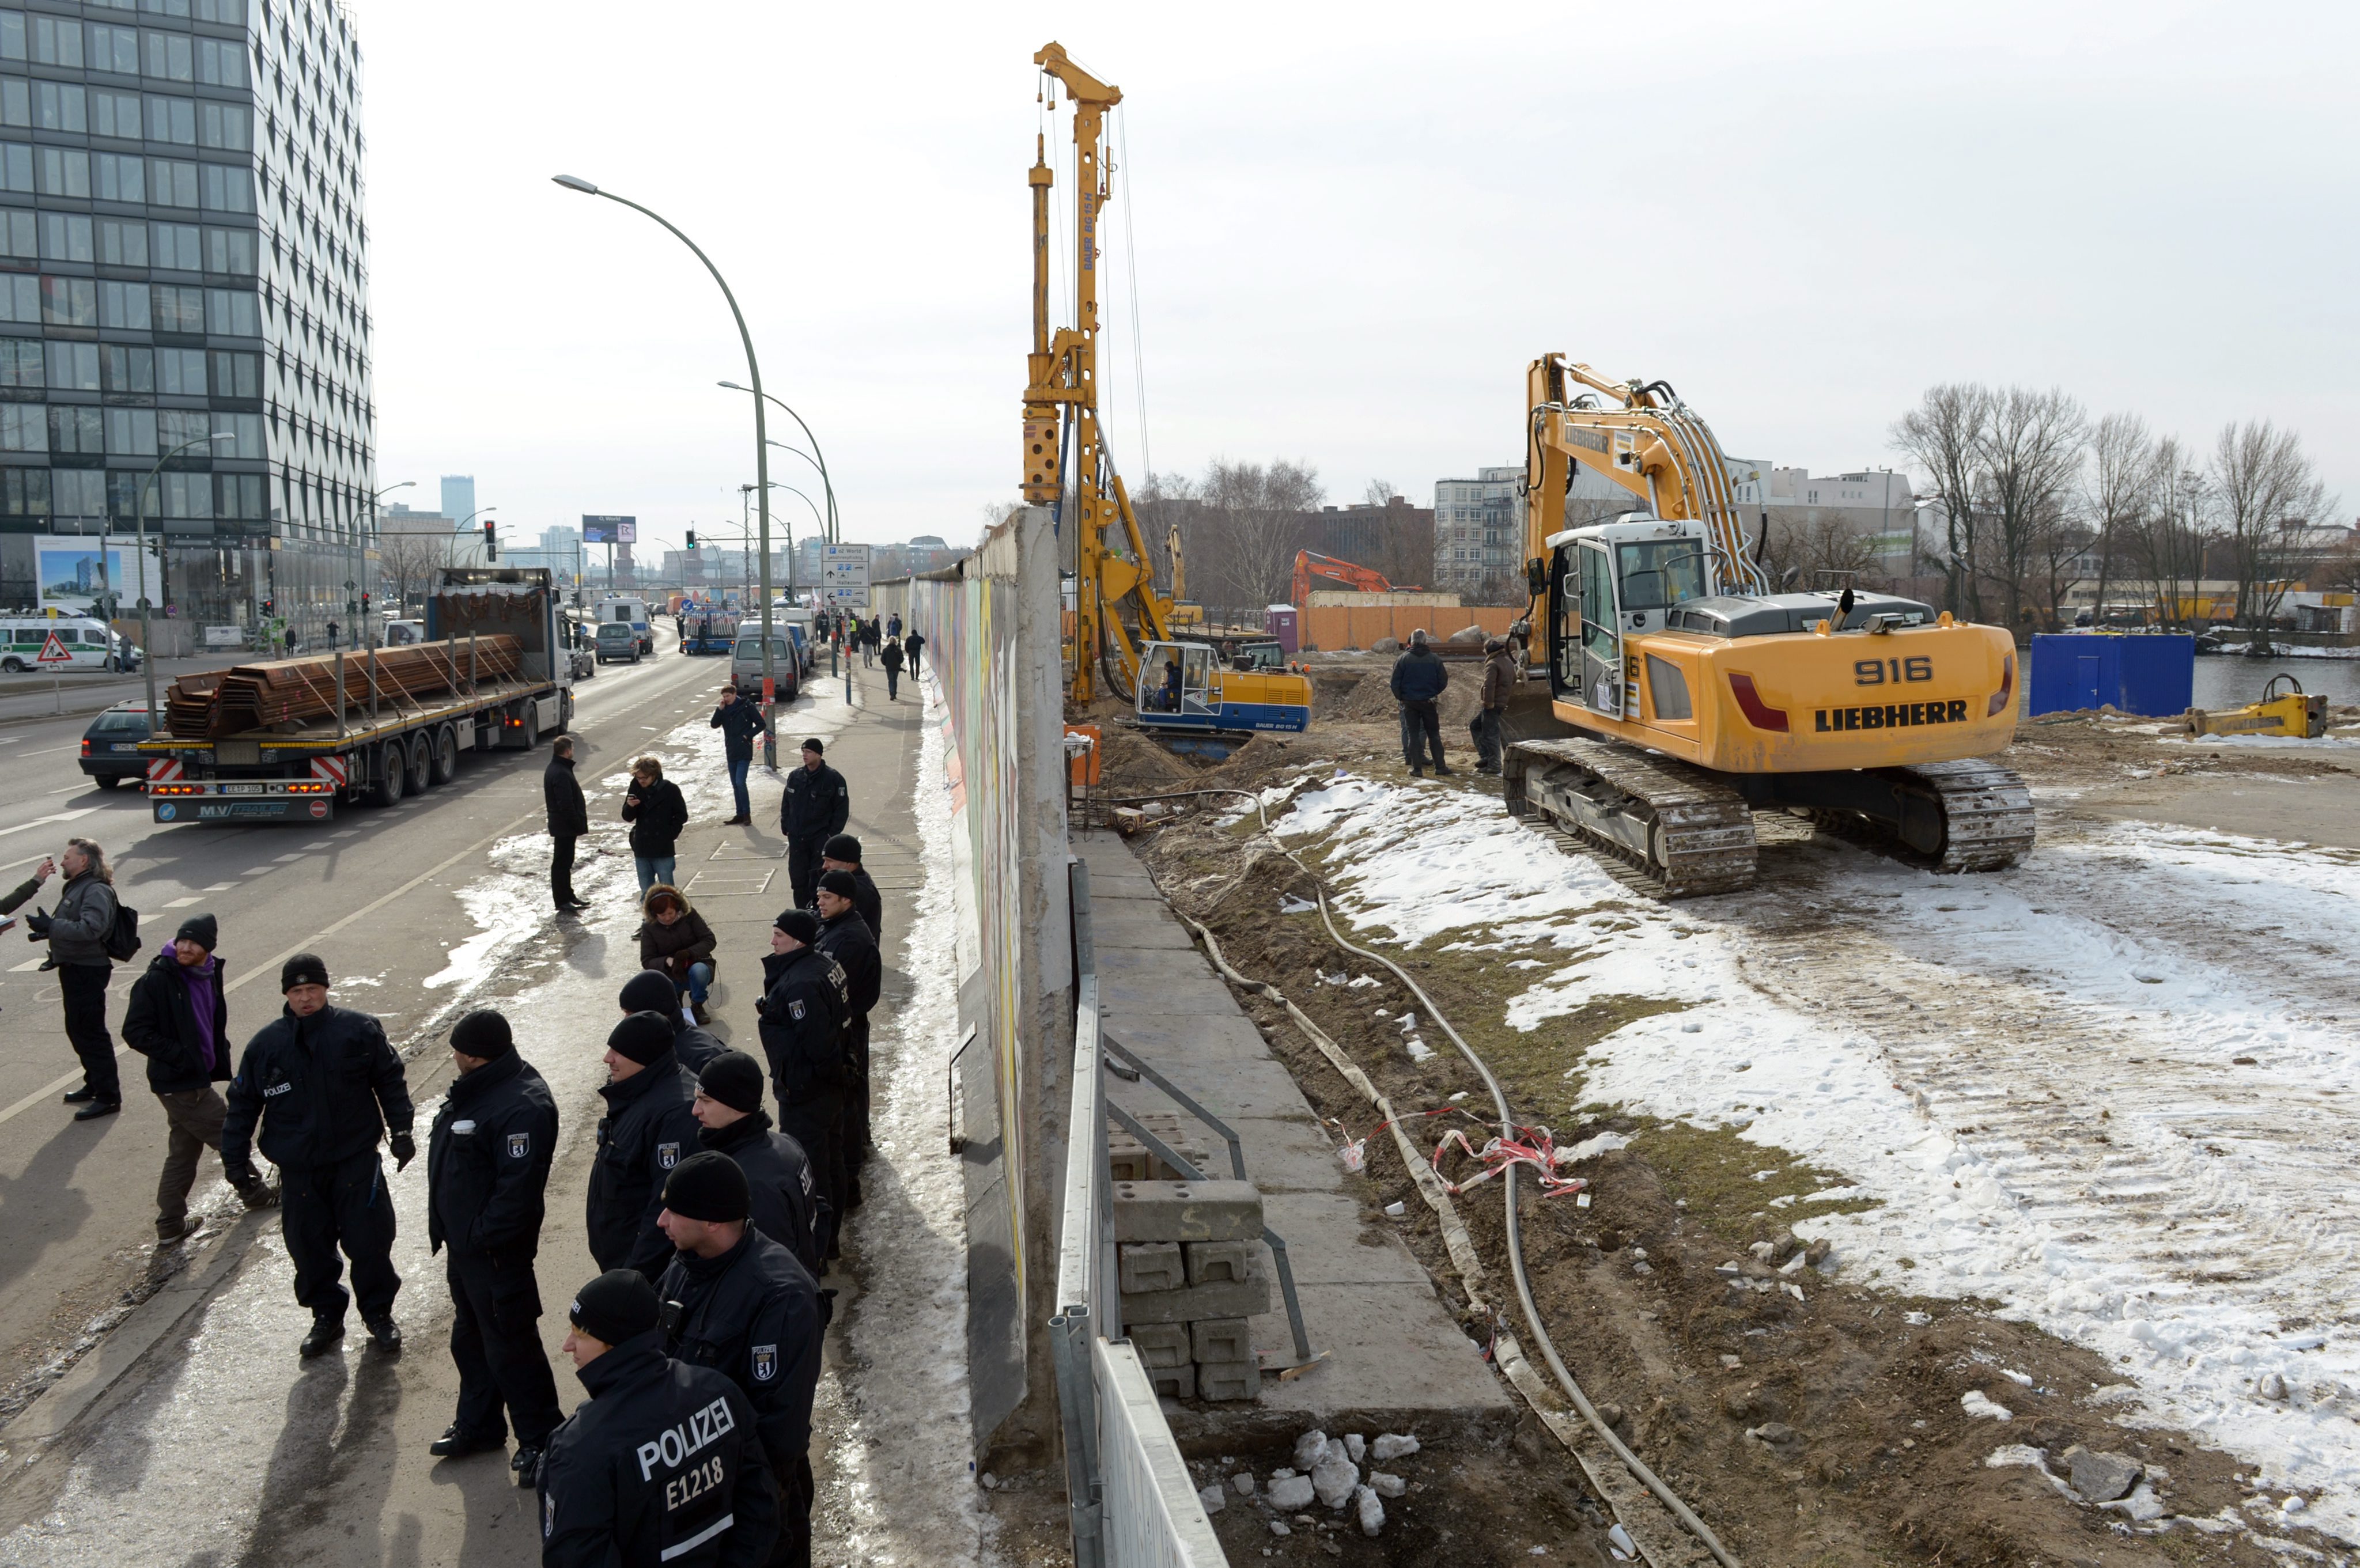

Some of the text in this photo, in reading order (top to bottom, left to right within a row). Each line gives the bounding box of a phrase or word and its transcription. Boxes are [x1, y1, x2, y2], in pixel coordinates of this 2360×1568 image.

[1084, 192, 1093, 271] BAUER BG 15 H
[1565, 427, 1609, 455] LIEBHERR
[1853, 655, 1934, 687] 916
[1816, 700, 1968, 732] LIEBHERR
[264, 1082, 292, 1097] POLIZEI
[752, 1345, 775, 1354] POLIZEI
[637, 1396, 735, 1482] POLIZEI
[666, 1456, 724, 1512] E1218
